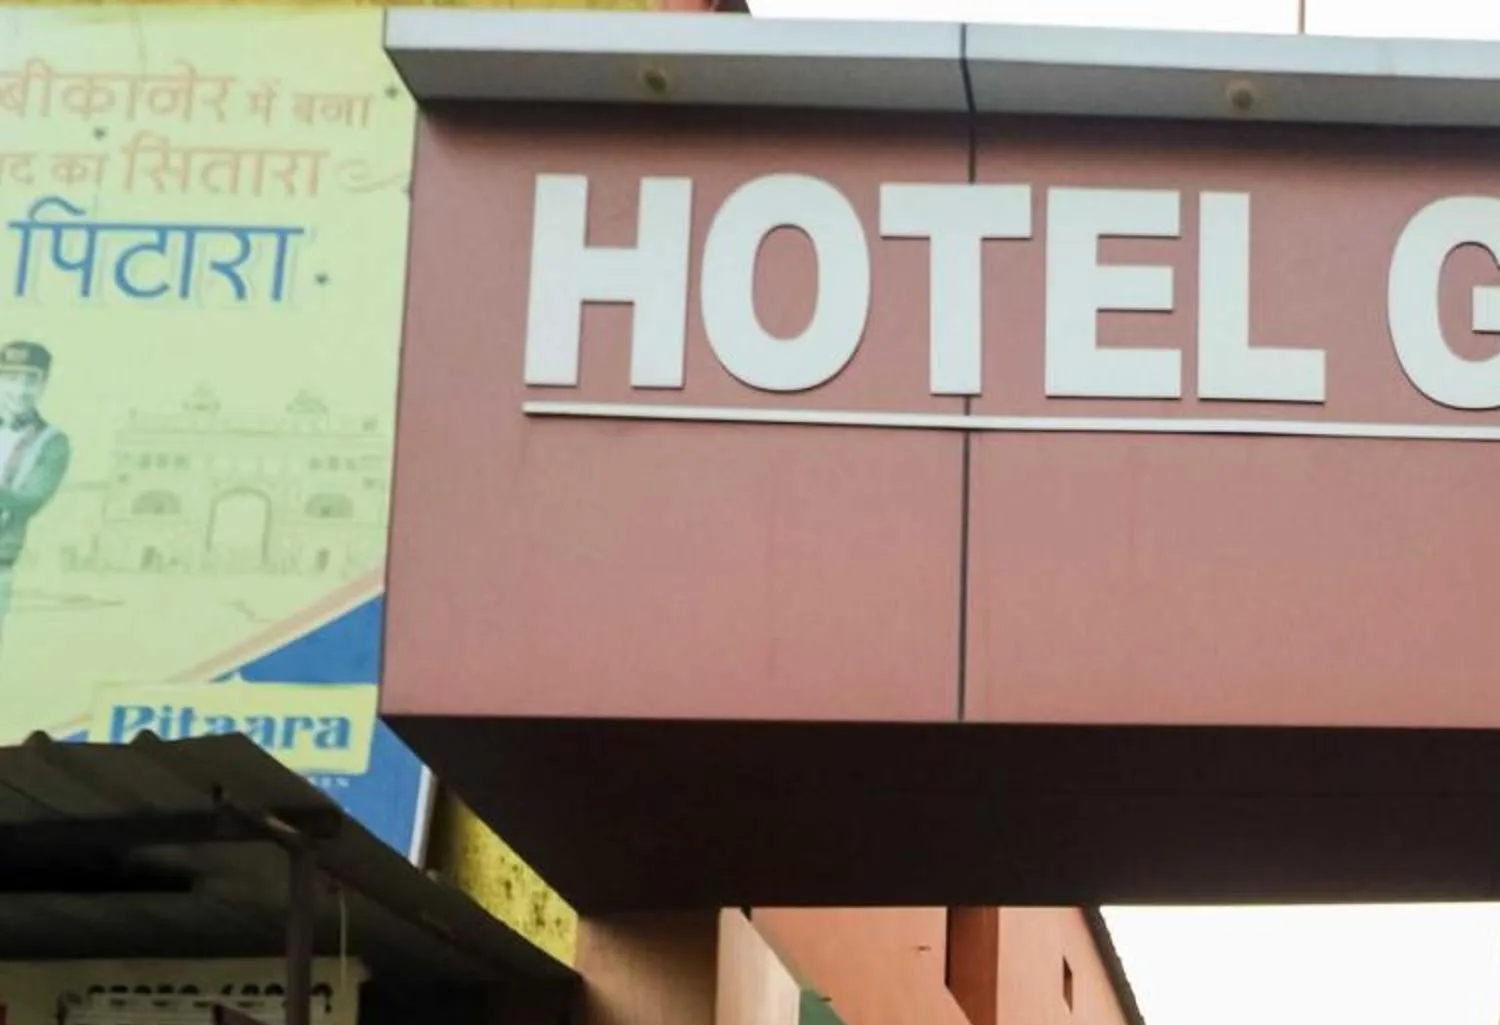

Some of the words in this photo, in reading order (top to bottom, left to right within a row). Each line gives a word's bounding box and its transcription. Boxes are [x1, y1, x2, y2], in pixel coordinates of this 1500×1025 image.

[246, 77, 287, 126] में
[293, 91, 376, 128] बना
[120, 130, 330, 196] सितारा
[8, 196, 305, 302] पिटारा
[524, 173, 1326, 403] HOTEL
